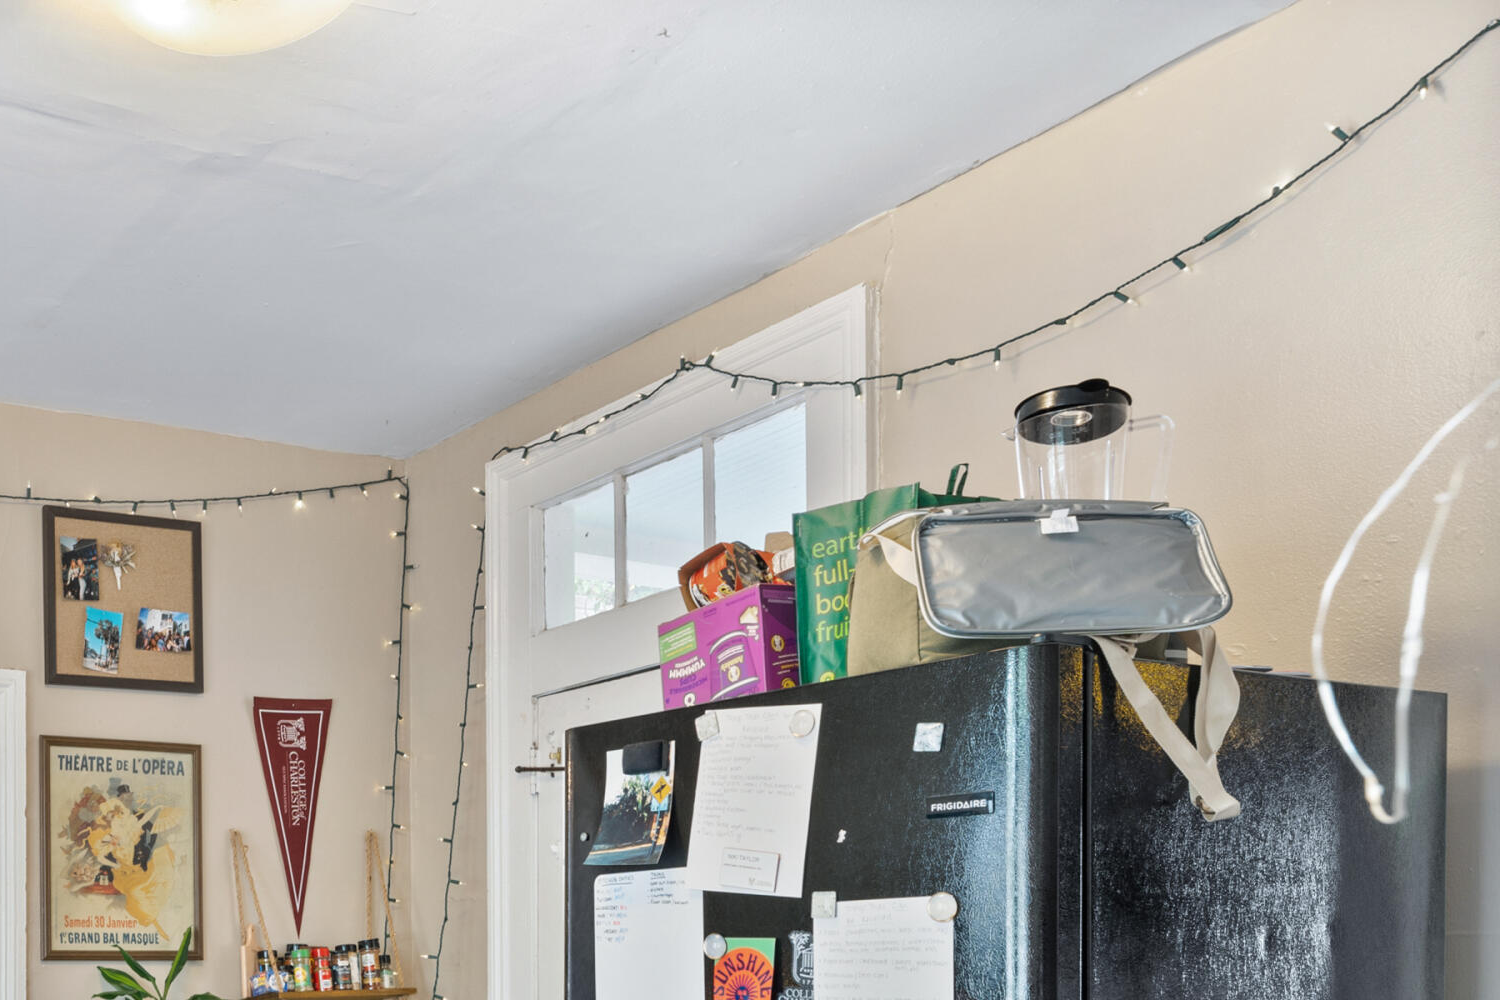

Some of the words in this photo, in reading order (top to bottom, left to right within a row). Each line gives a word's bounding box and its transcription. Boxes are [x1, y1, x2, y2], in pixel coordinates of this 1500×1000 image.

[812, 528, 870, 558] eart
[816, 616, 850, 643] frui
[116, 760, 129, 771] DE
[289, 751, 301, 826] CHARLESTON
[298, 760, 307, 811] COLLEGE
[931, 799, 987, 812] FRIGIDAIRE
[64, 915, 93, 928] Samedi
[94, 916, 105, 928] 30
[107, 916, 137, 928] Janvier
[68, 932, 100, 944] GRAND
[103, 933, 120, 944] BAL
[713, 953, 772, 998] SUNSHINE
